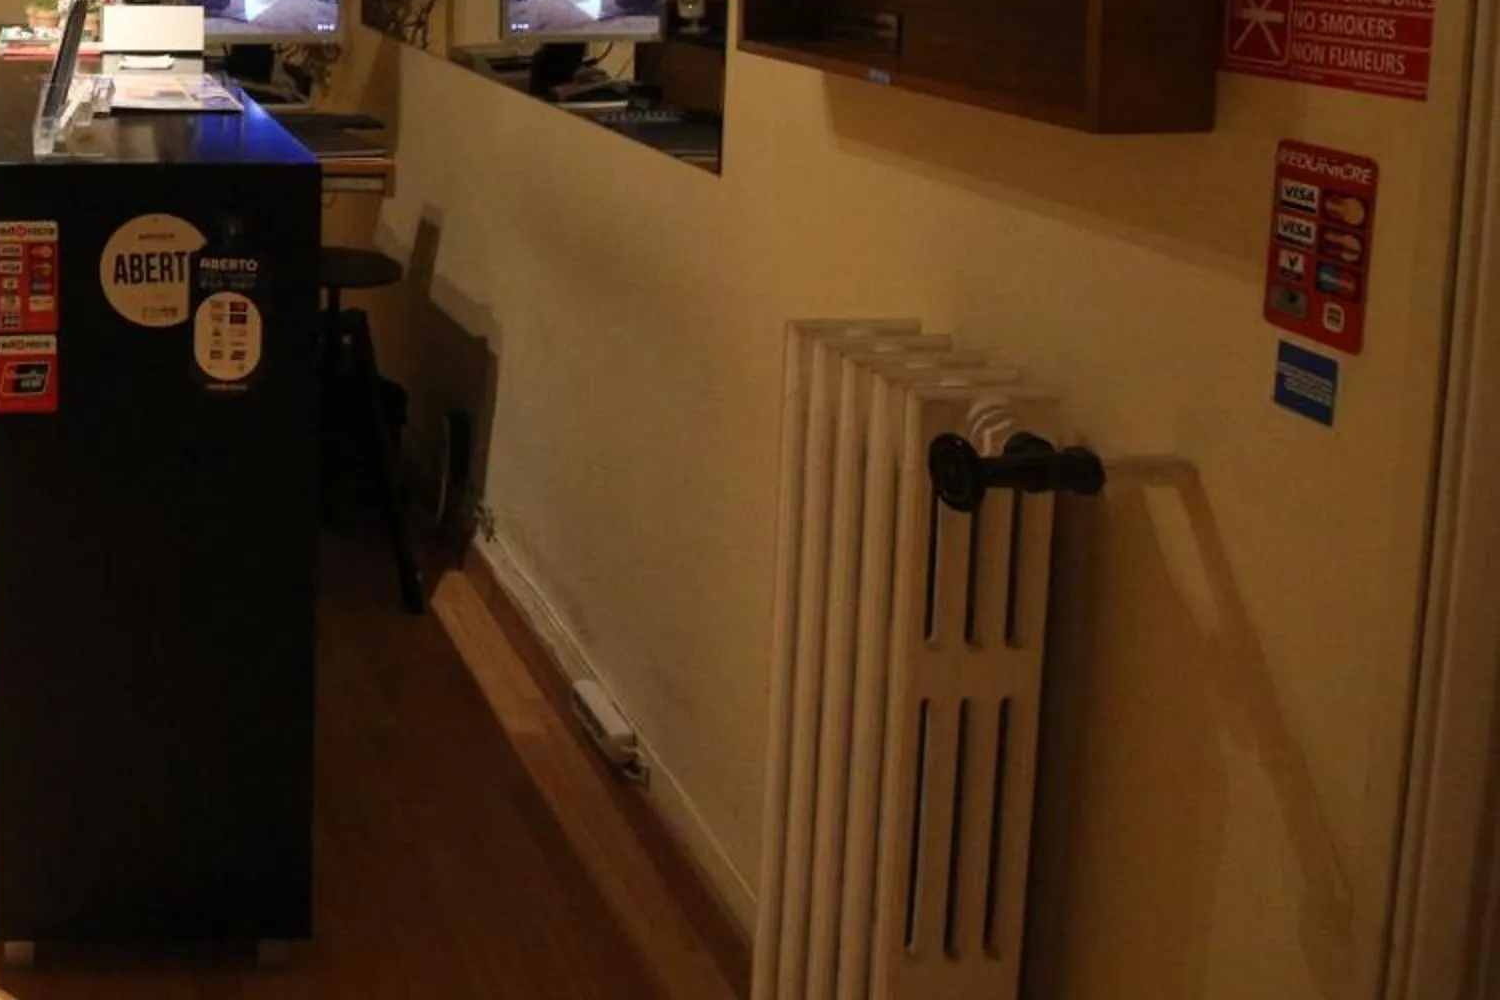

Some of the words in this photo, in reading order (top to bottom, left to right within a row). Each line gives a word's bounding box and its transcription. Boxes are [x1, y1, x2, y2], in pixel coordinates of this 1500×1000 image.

[1293, 6, 1316, 30] NO
[1319, 12, 1397, 40] SMOKERS
[1291, 41, 1325, 66] NON
[1329, 47, 1406, 75] FUMEURS
[1279, 147, 1373, 185] REDUNICRE
[1284, 184, 1315, 203] VISA
[1281, 220, 1312, 239] VISA
[113, 251, 190, 286] ABERT
[200, 258, 259, 273] ABERTO
